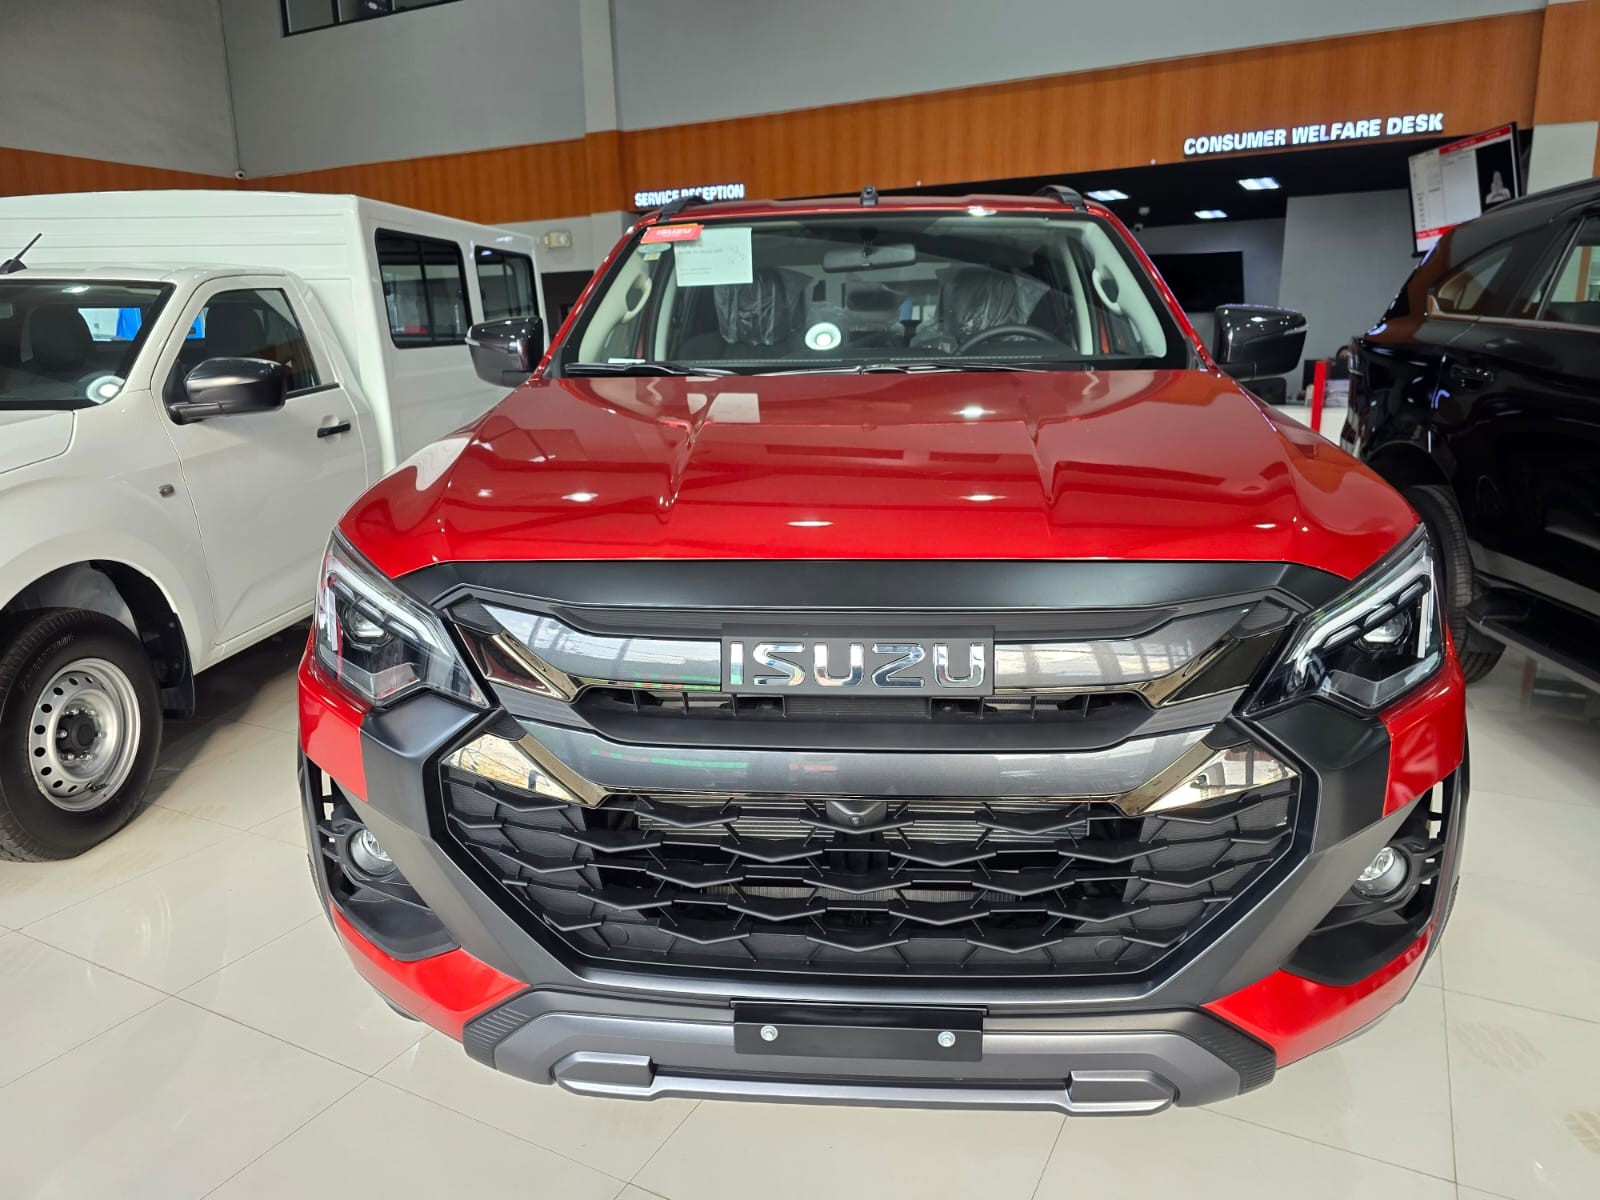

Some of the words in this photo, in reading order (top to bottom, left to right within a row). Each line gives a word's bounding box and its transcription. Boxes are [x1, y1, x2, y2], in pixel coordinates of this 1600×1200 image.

[1184, 128, 1286, 155] CONSUMER
[1292, 118, 1382, 145] WELFARE
[1386, 112, 1444, 135] DESK
[634, 189, 680, 207] SERVICE
[729, 641, 985, 688] ISUZU
